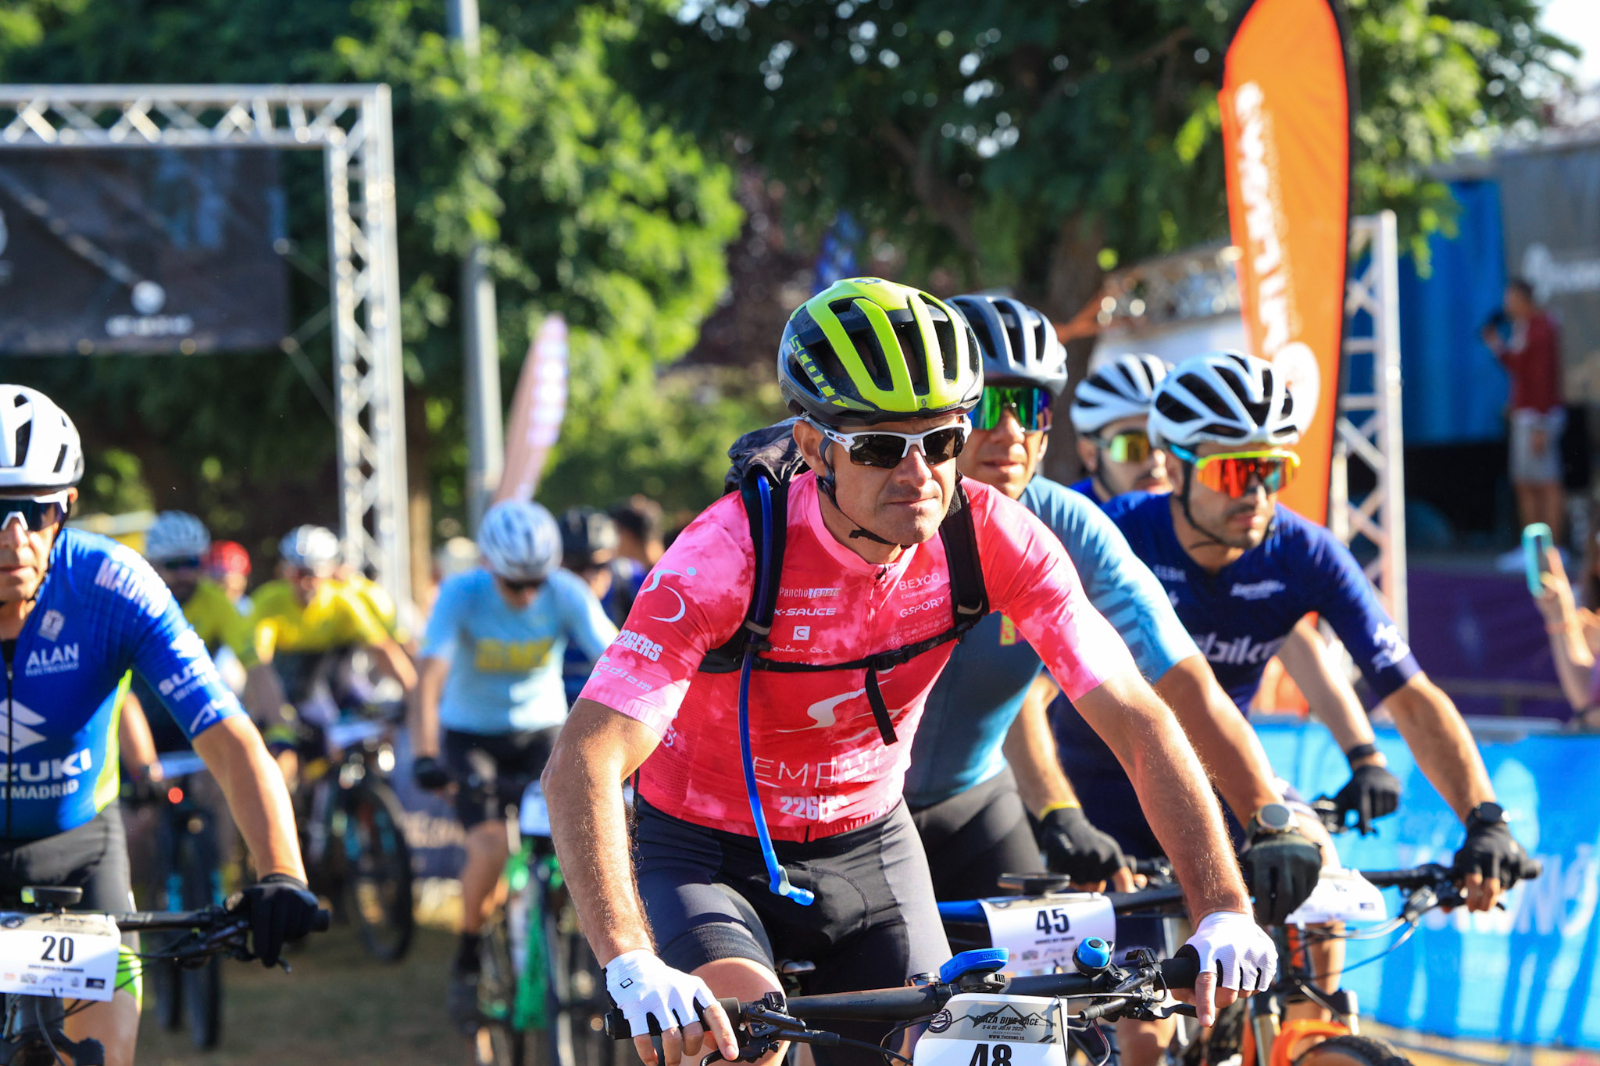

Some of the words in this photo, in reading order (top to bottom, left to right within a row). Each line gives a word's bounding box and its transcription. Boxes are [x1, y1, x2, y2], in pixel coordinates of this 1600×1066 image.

[899, 572, 940, 591] BEXCO
[25, 643, 79, 671] ALAN
[772, 644, 805, 653] enter
[11, 778, 79, 799] MADRID
[1036, 908, 1070, 935] 45
[41, 935, 74, 963] 20
[1021, 1018, 1039, 1026] ACE
[967, 1044, 1012, 1066] 48
